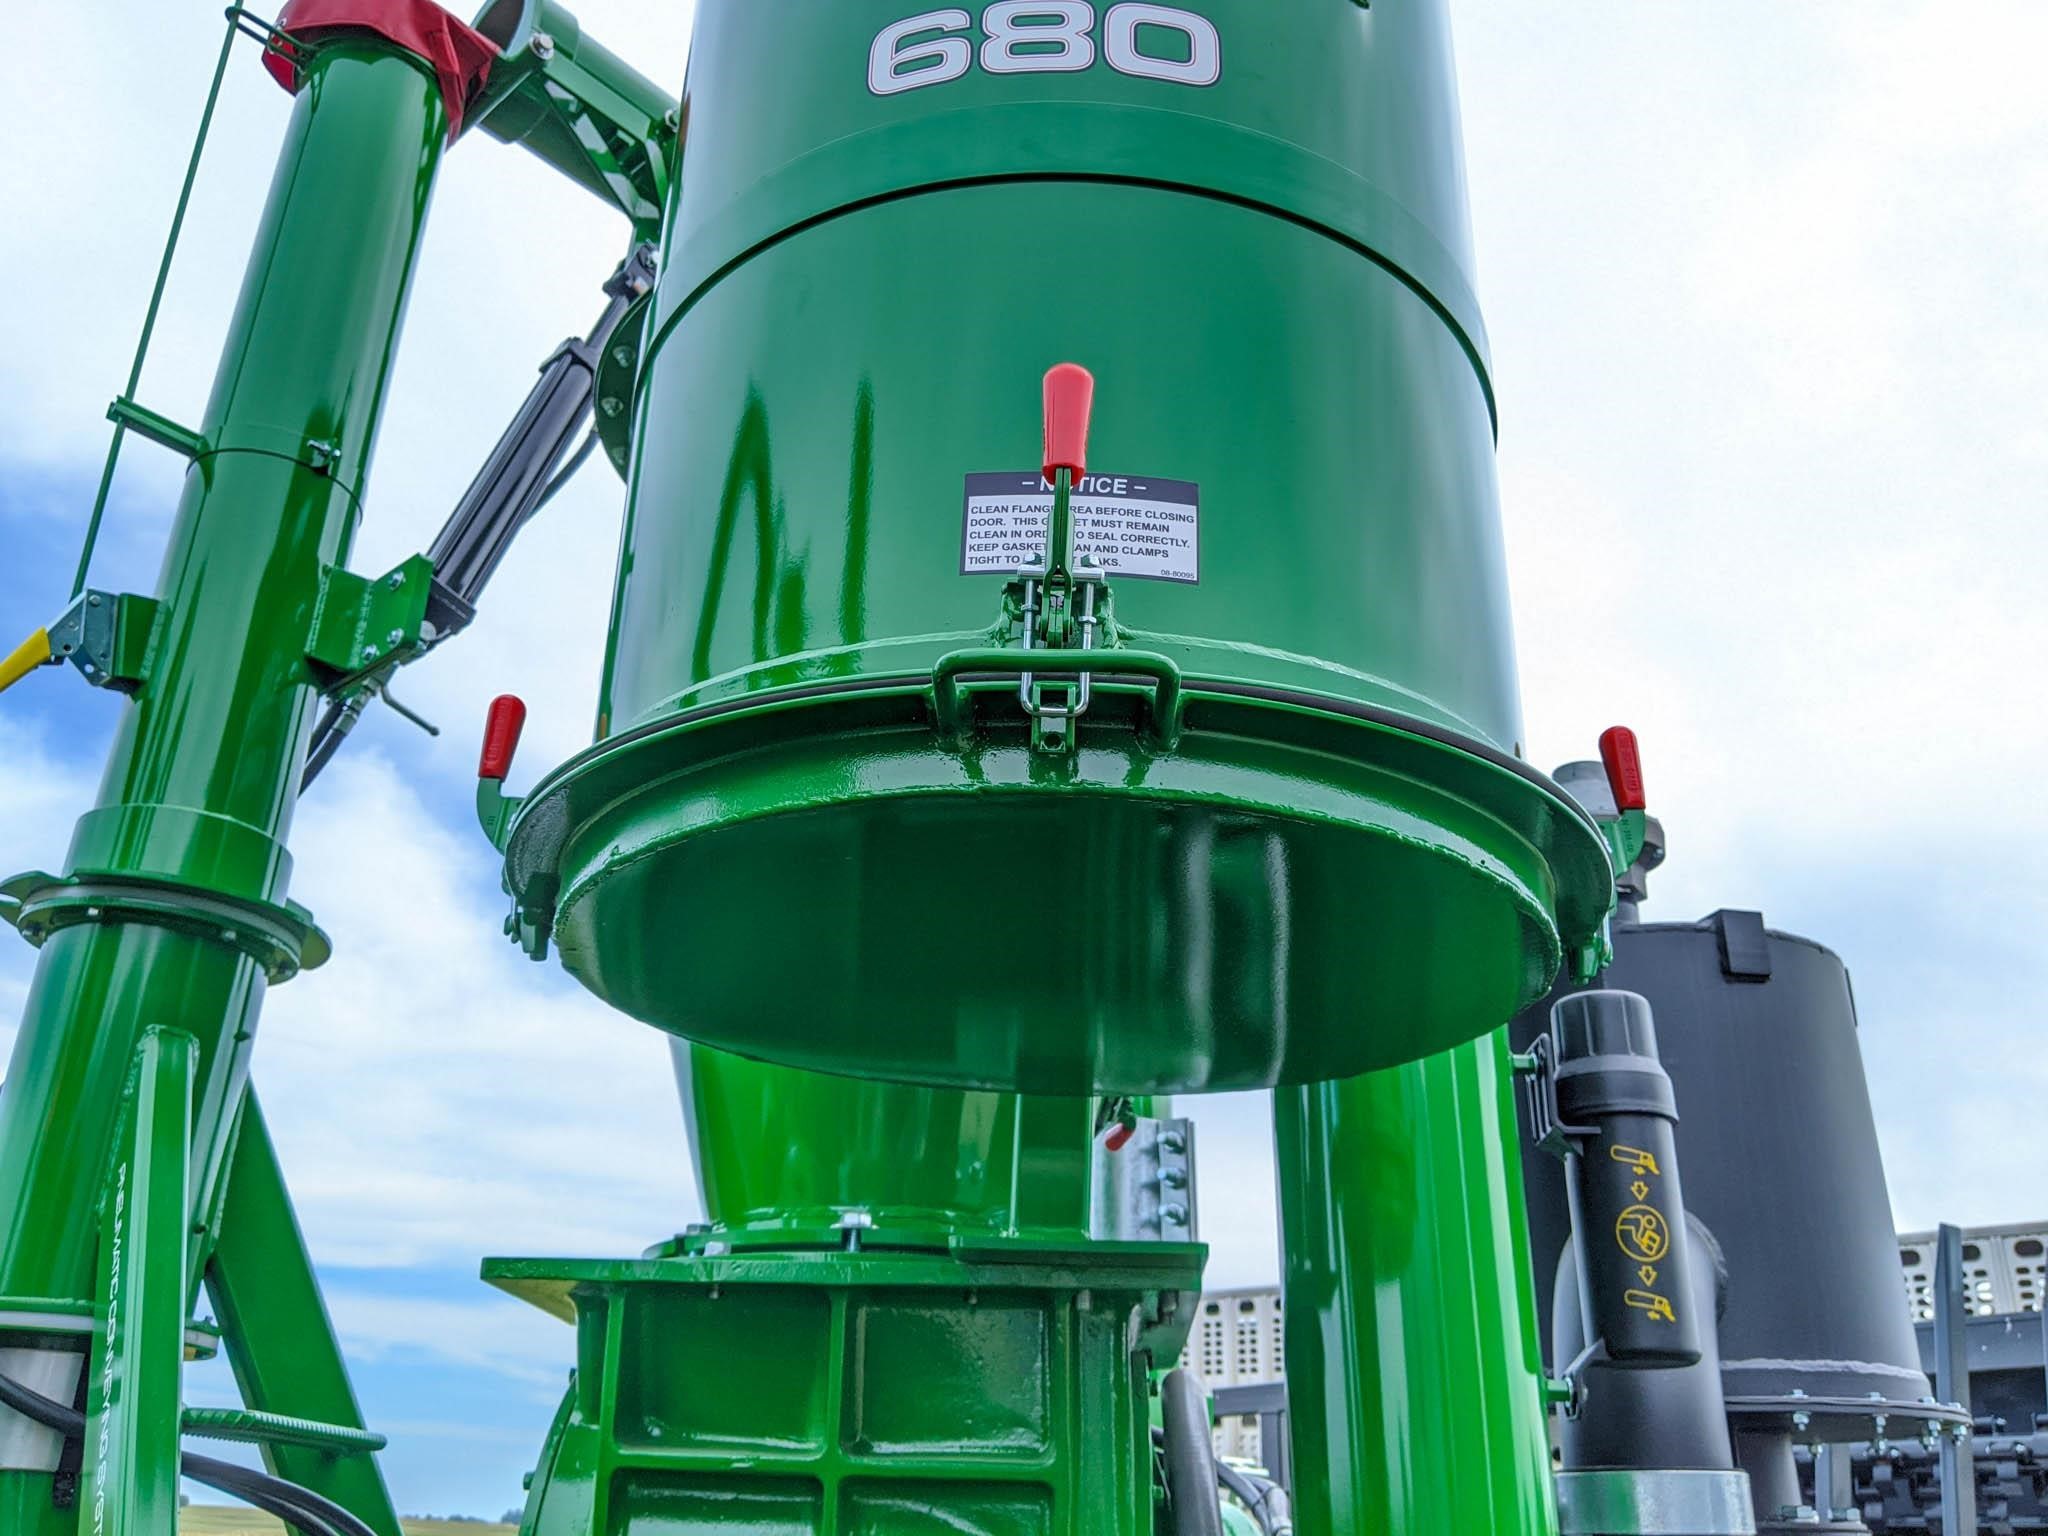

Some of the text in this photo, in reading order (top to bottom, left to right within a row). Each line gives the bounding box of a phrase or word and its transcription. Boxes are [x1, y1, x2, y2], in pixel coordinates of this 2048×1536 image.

[866, 0, 1221, 96] 680
[1040, 475, 1128, 495] NTICE
[971, 505, 1009, 514] CLEAN
[1070, 505, 1093, 514] REA
[1095, 506, 1142, 517] BEFORE
[1145, 510, 1195, 523] CLOSING
[970, 518, 1007, 527] DOOR.
[1012, 517, 1038, 526] THIS
[1091, 519, 1123, 529] MUST
[1126, 521, 1170, 532] REMAIN
[969, 530, 1007, 539] CLEAN
[1011, 530, 1021, 538] IN
[1087, 531, 1118, 541] SEAL
[1120, 533, 1191, 548] CORRECTLY.
[968, 543, 998, 552] KEEP
[1093, 545, 1119, 554] AND
[1121, 546, 1169, 558] CLAMPS
[968, 555, 1002, 565] TIGHT
[1005, 555, 1020, 564] TO
[110, 1162, 127, 1300] PNEUMATIC
[99, 1300, 118, 1459] CONVEYING
